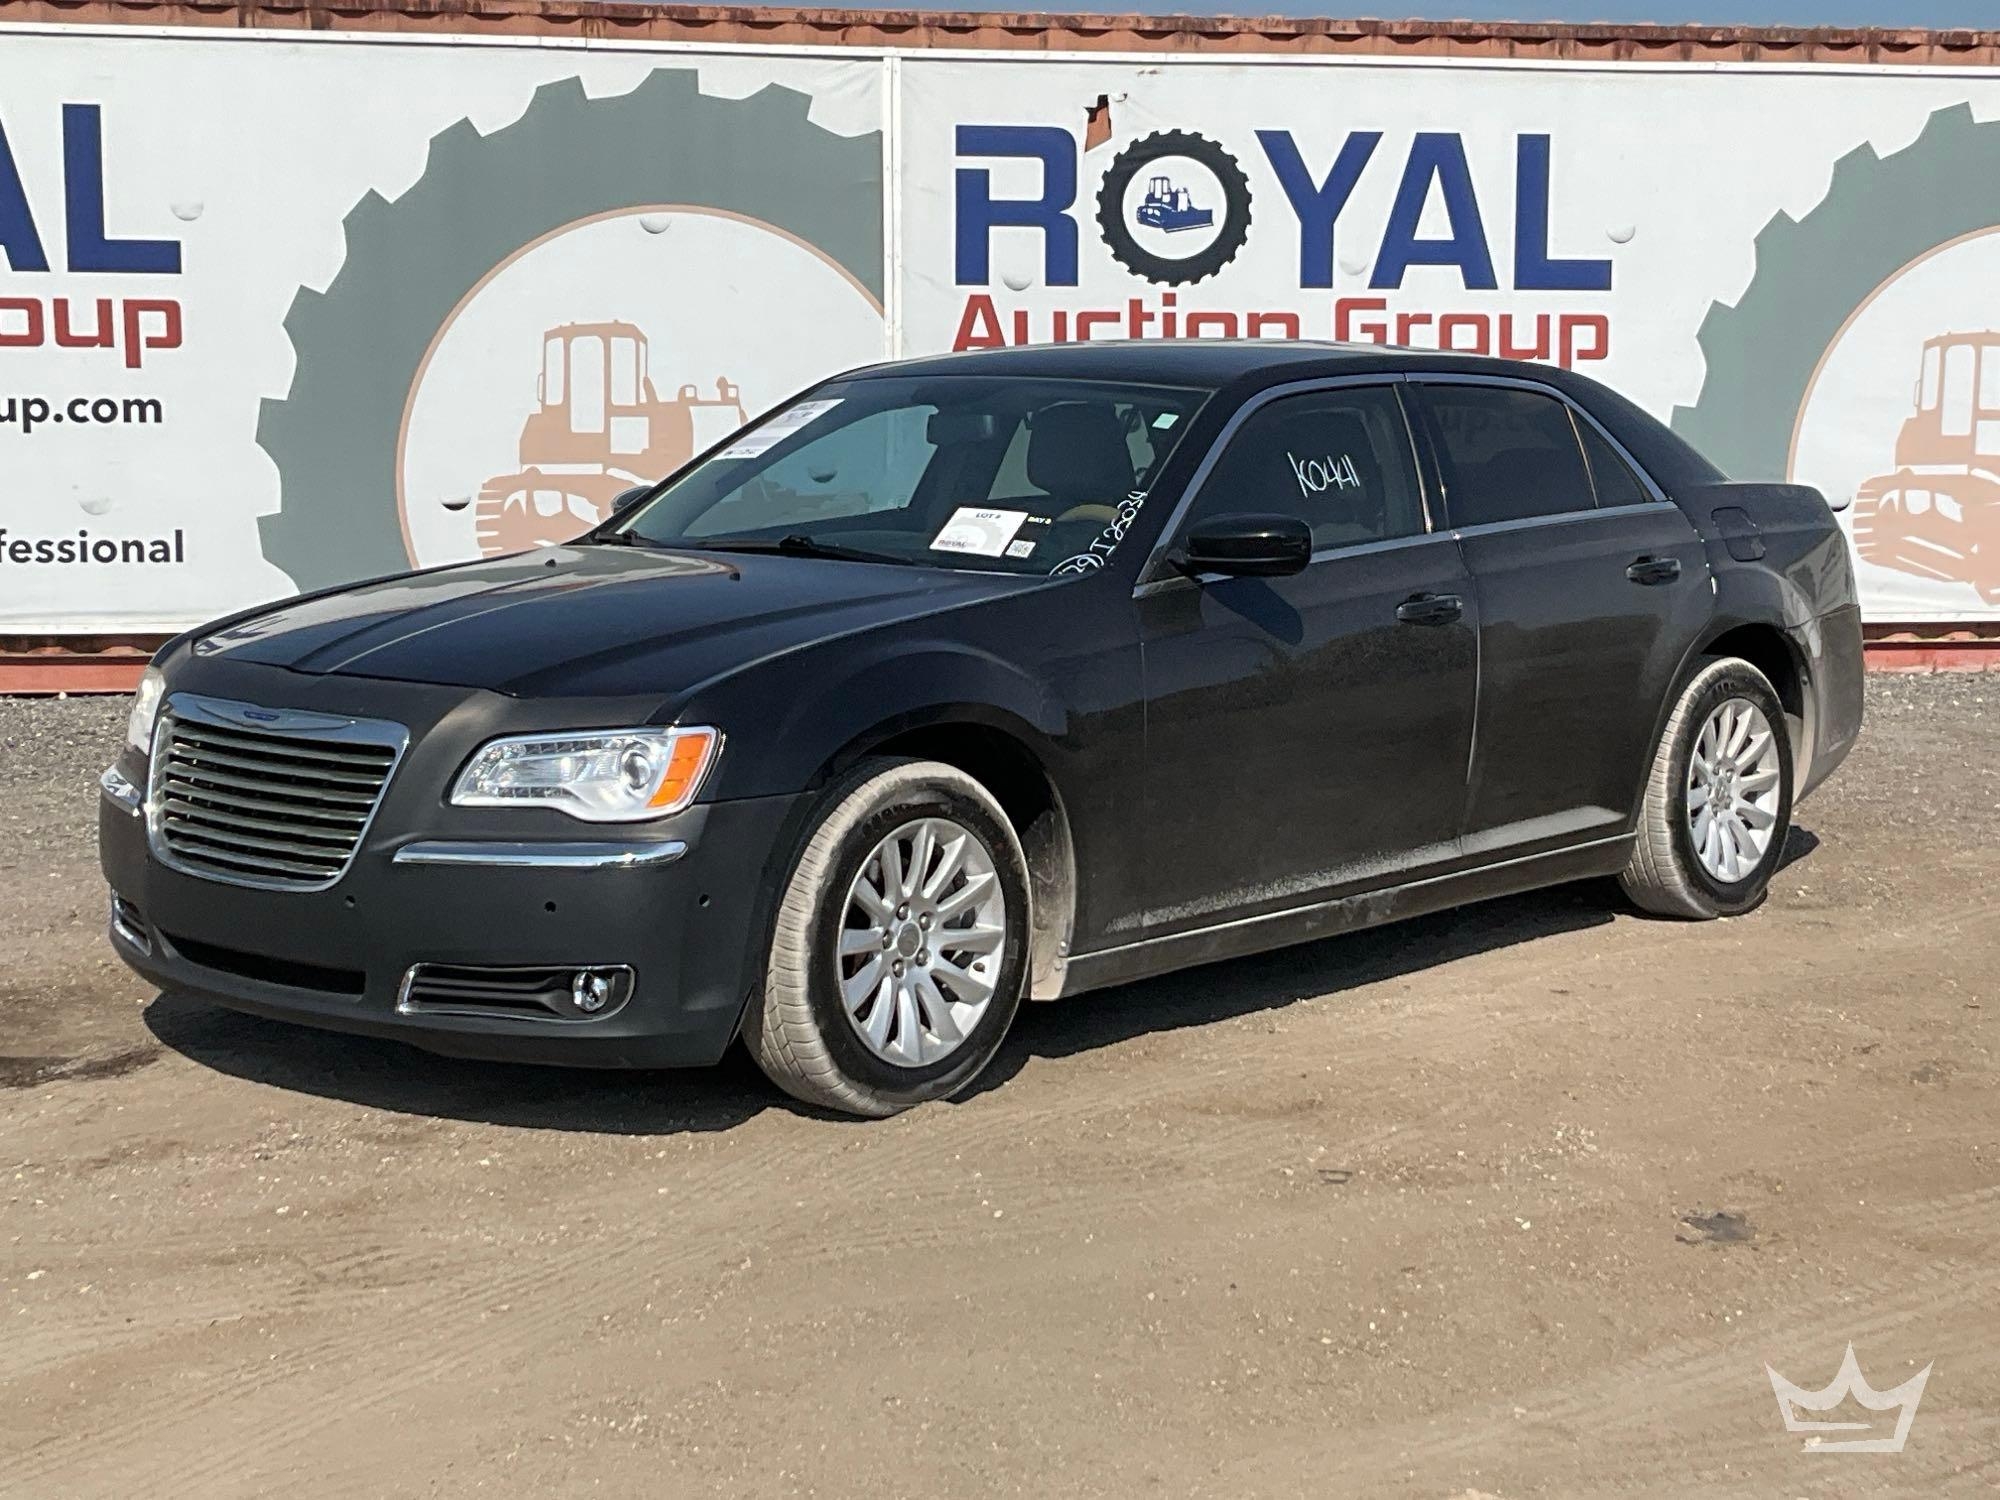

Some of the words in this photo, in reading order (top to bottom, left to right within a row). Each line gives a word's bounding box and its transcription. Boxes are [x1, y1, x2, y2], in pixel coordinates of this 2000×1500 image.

[955, 124, 1612, 290] ROYAL
[0, 298, 182, 368] oup
[952, 292, 1300, 353] Auction
[1335, 297, 1610, 369] Group
[0, 397, 163, 434] up.com
